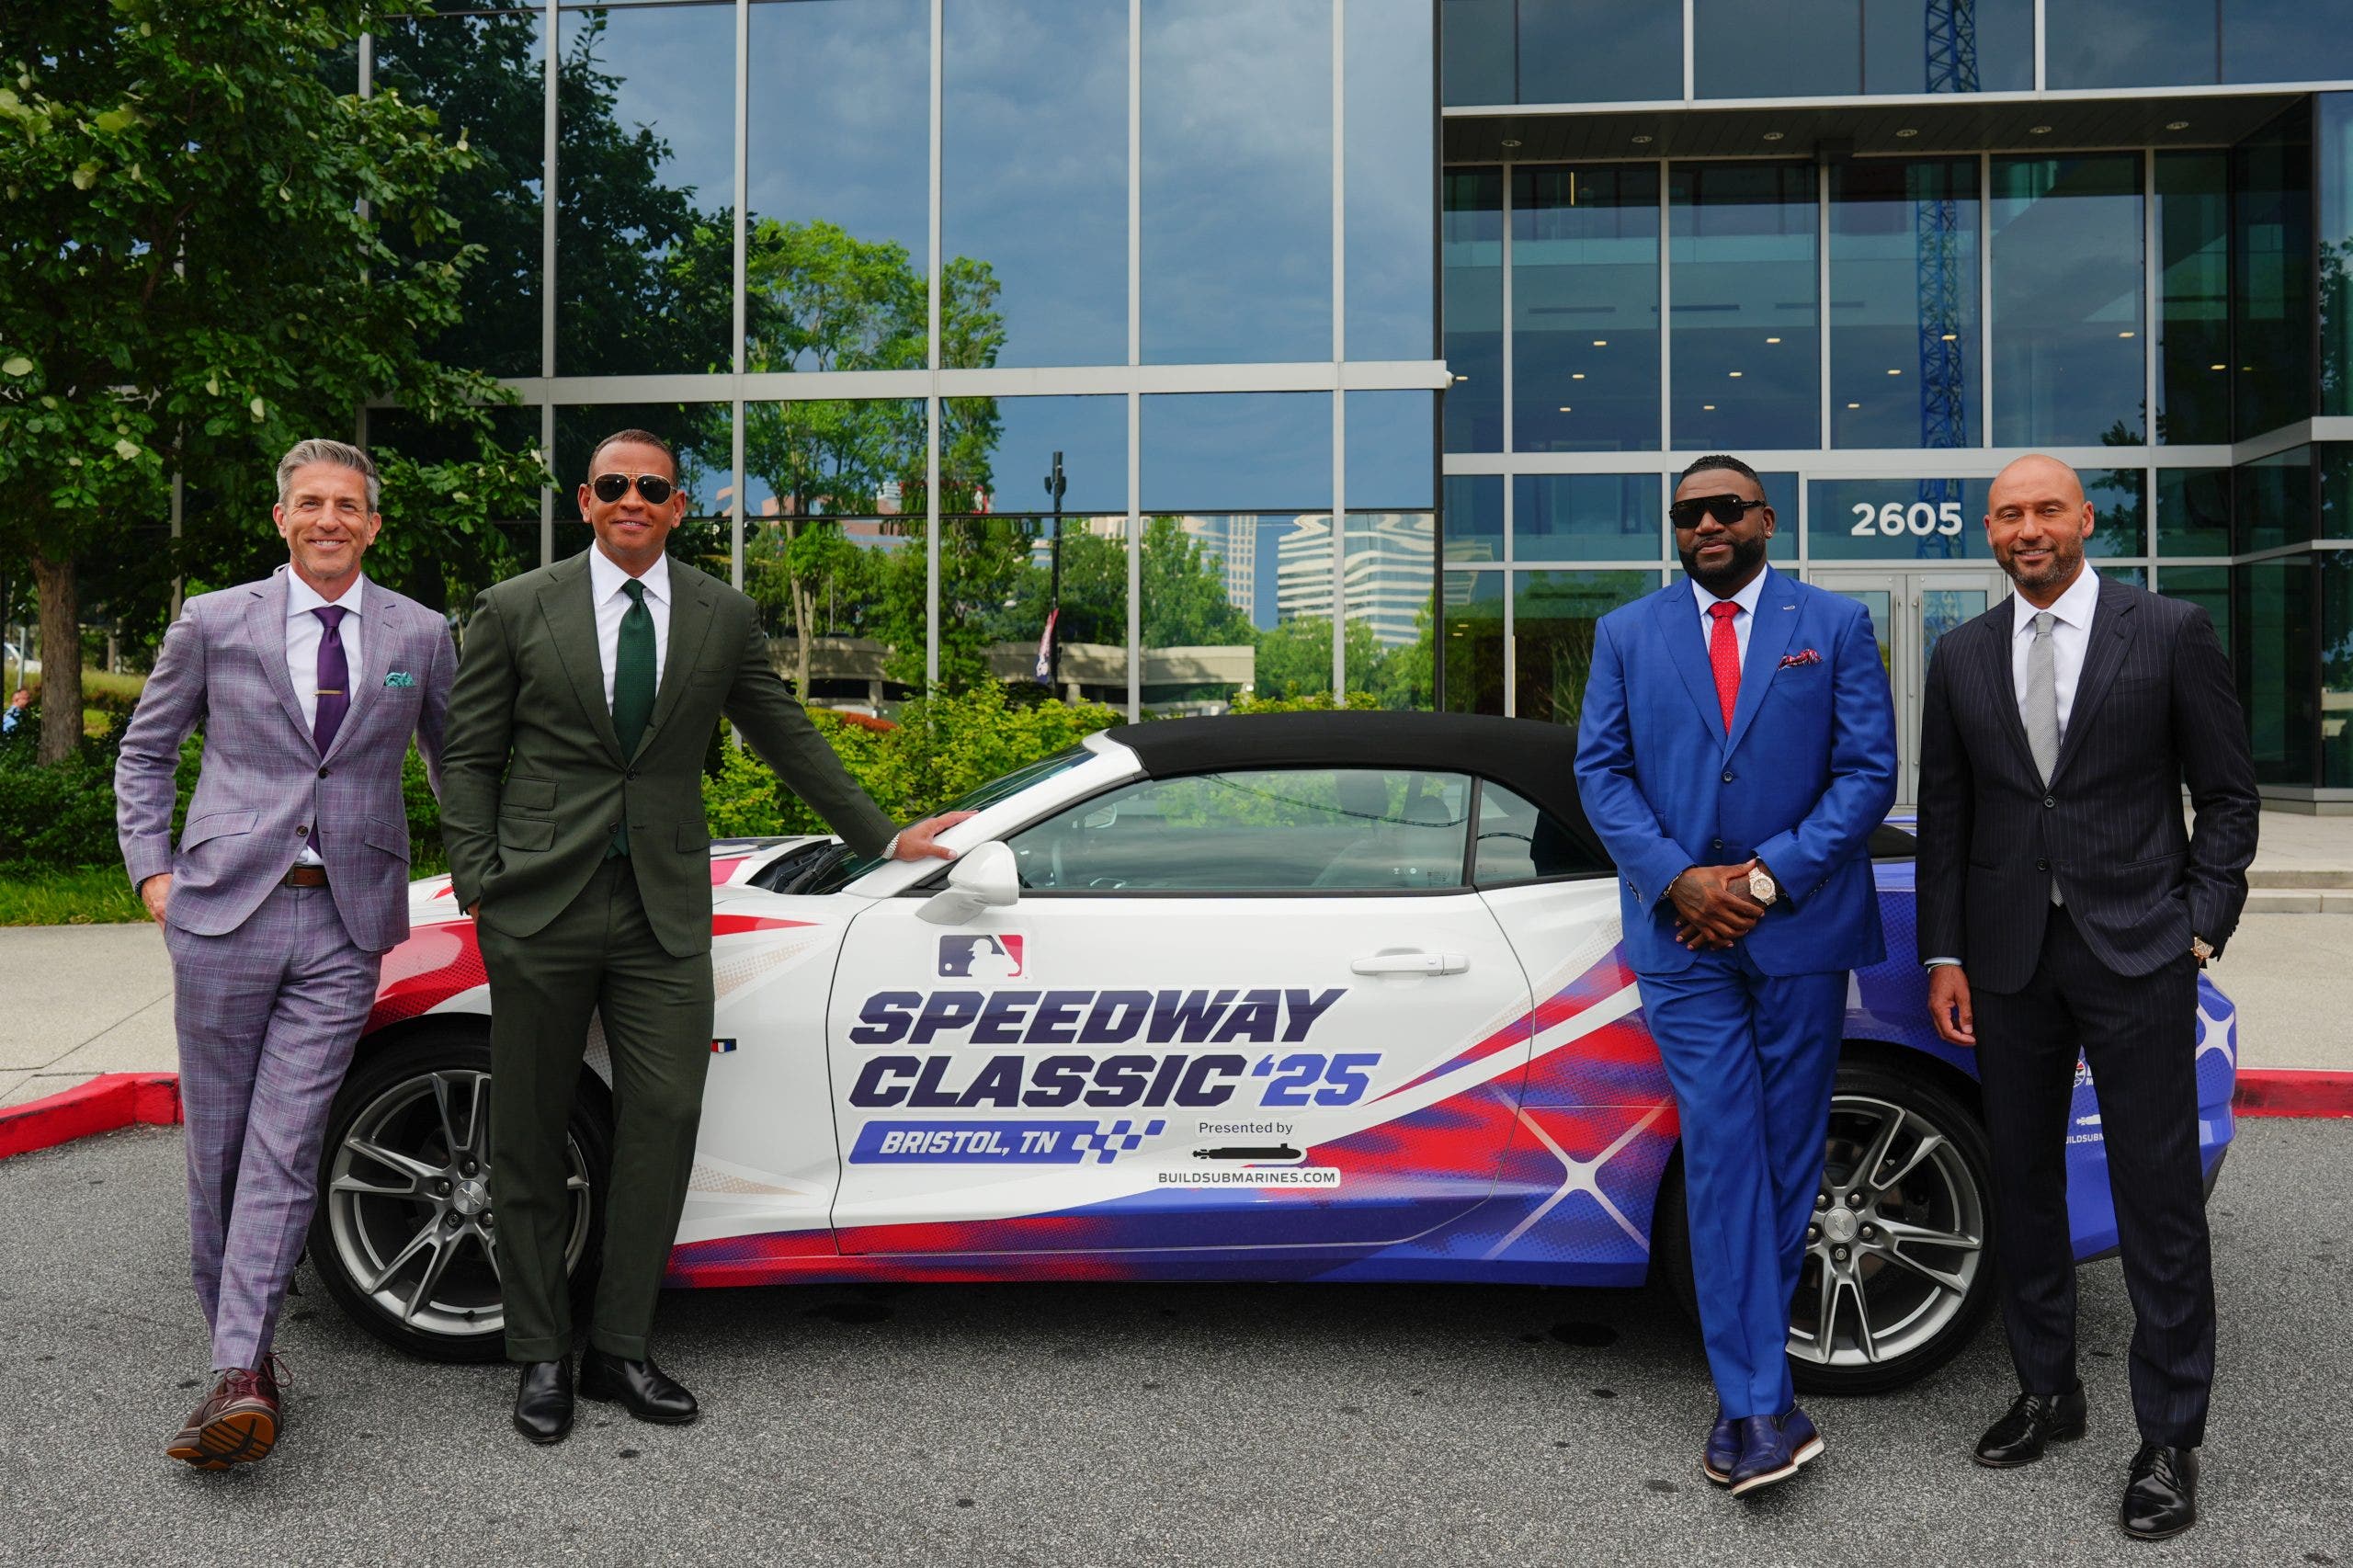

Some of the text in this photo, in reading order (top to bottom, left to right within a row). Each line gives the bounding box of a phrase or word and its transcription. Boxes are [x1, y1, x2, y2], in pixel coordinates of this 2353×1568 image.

[1851, 502, 1962, 536] 2605
[848, 988, 1347, 1045] SPEEDWAY
[847, 1054, 1248, 1108] CLASSIC
[1199, 1121, 1293, 1135] Presented by
[879, 1131, 1061, 1157] BRISTOL, TN
[1158, 1172, 1336, 1183] BUILDSUBMARINES.COM
